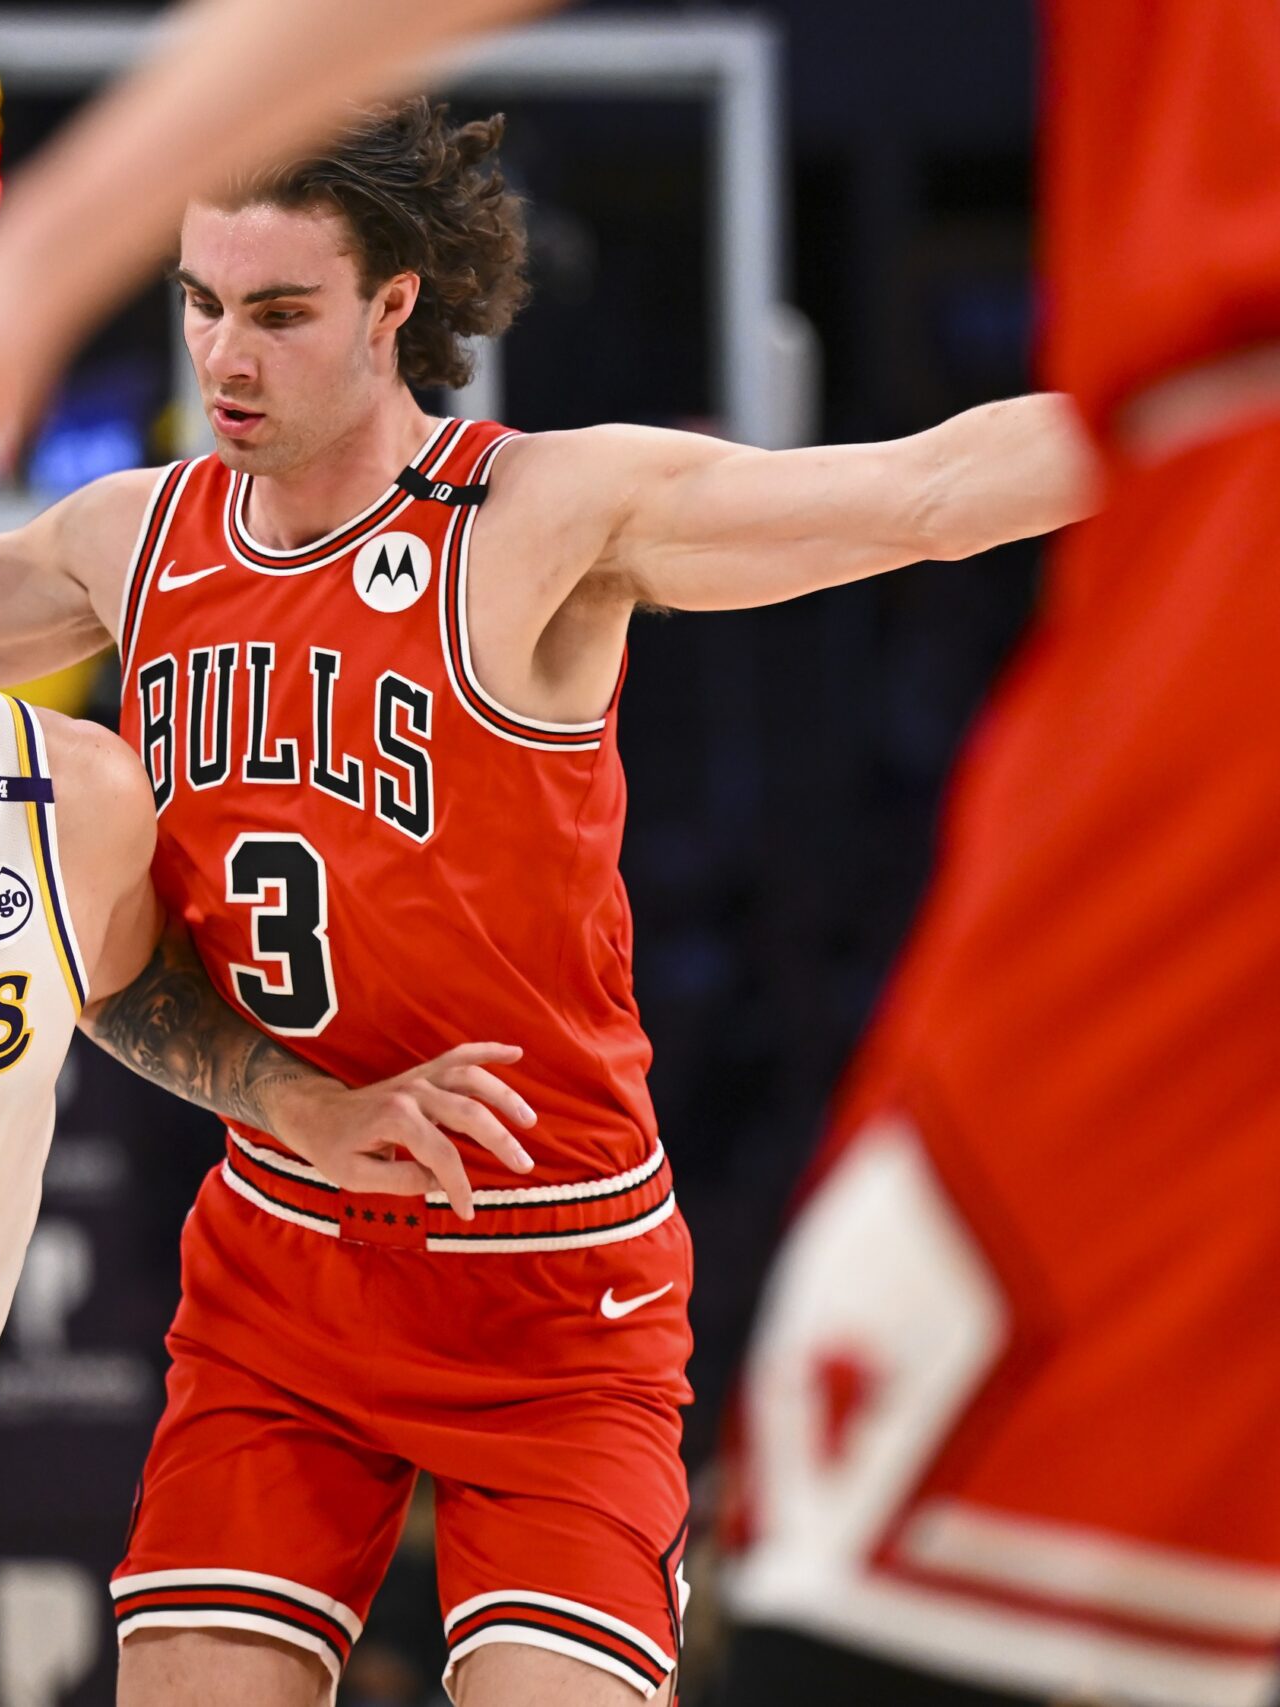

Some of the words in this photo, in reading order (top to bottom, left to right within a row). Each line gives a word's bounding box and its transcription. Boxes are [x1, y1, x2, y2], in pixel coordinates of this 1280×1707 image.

[429, 483, 453, 501] 10
[137, 641, 435, 844] BULLS
[224, 832, 338, 1037] 3
